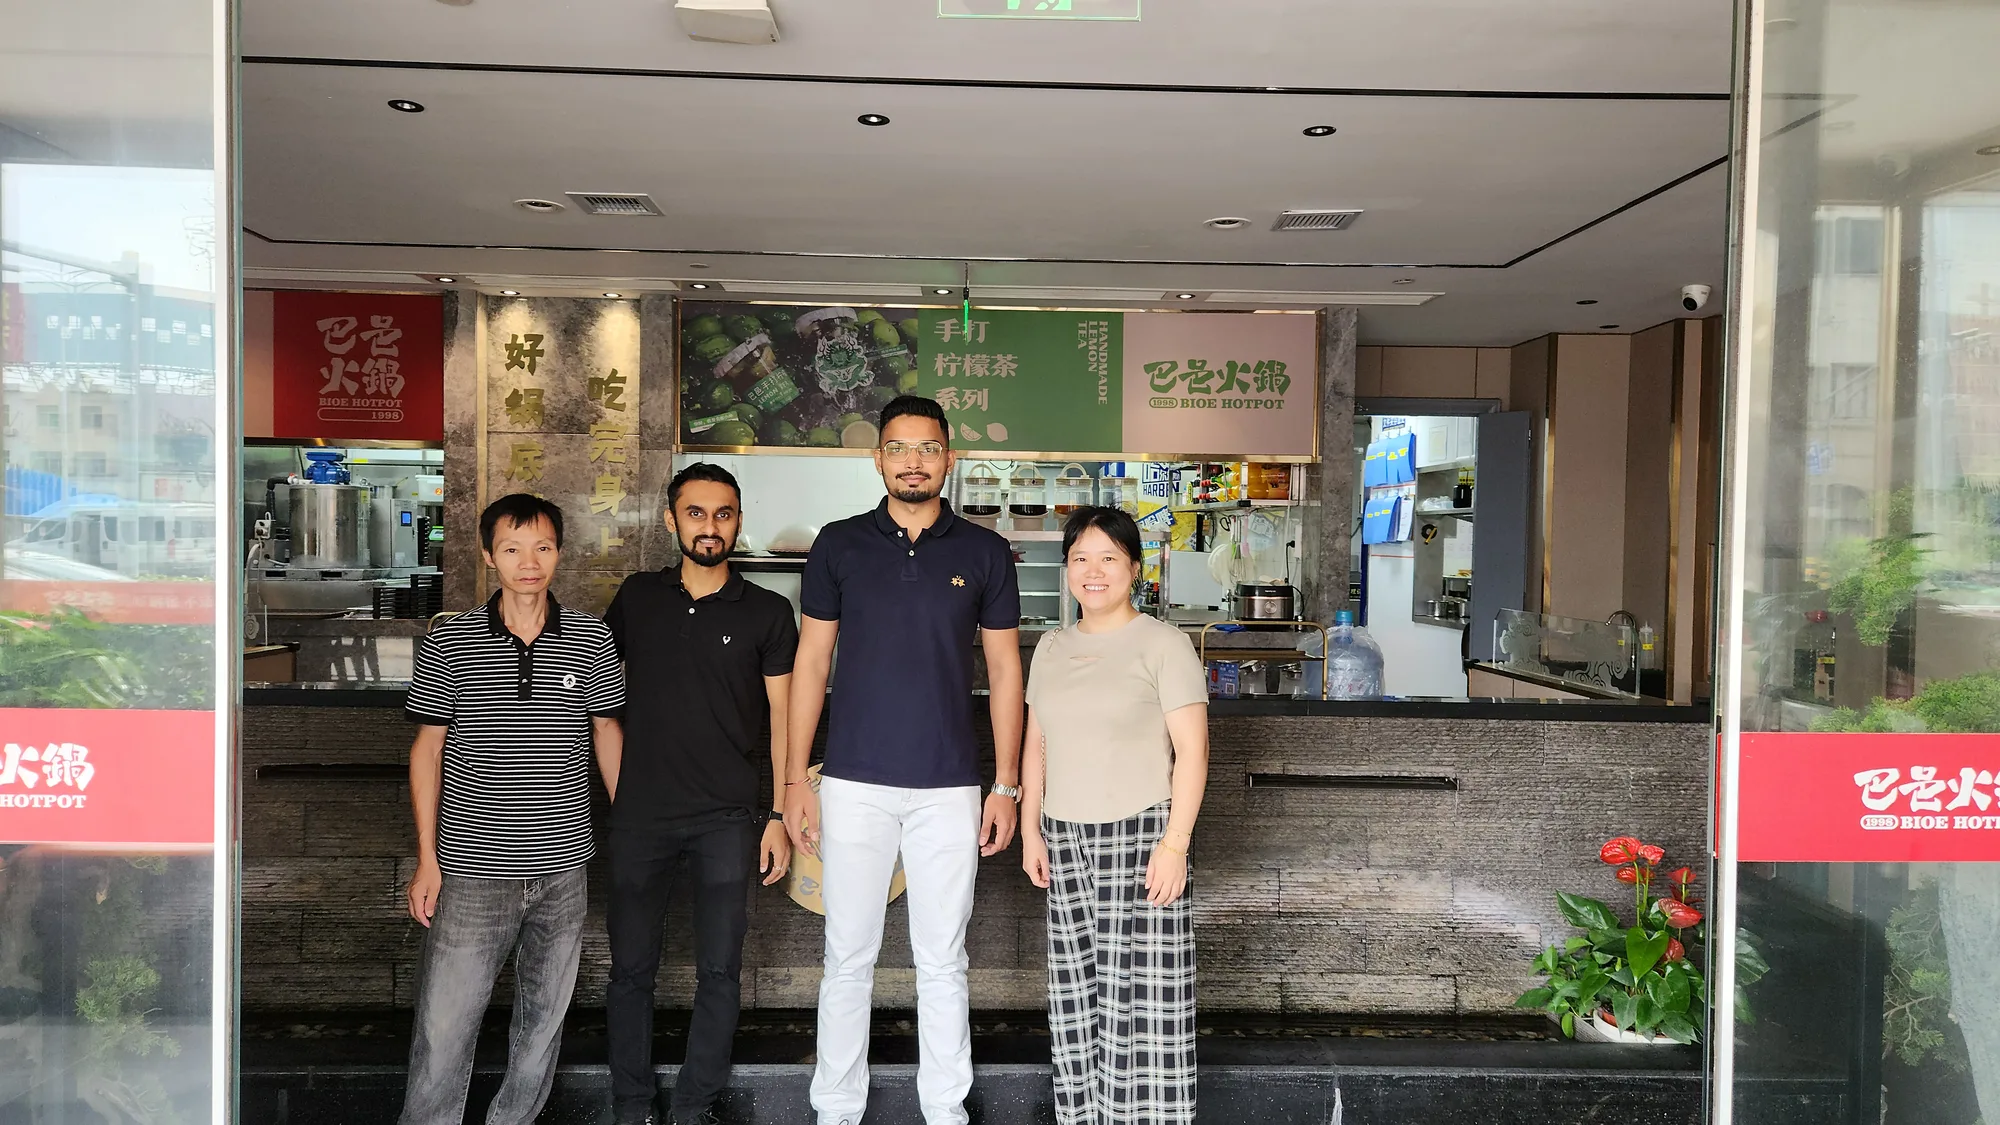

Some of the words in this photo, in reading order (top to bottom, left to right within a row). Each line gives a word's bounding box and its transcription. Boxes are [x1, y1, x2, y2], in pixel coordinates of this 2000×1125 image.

[934, 318, 991, 344] 手打
[1078, 320, 1088, 349] TEA
[1088, 321, 1098, 372] LEMON
[934, 352, 1019, 378] 柠檬茶
[1098, 321, 1108, 405] HANDMADE
[319, 398, 348, 406] BIOE
[352, 399, 402, 407] HOTPOT
[936, 386, 989, 412] 系列
[1180, 399, 1217, 408] BIOE
[1221, 399, 1285, 409] HOTPOT
[371, 411, 400, 420] 1998
[504, 333, 545, 500] 好锅底
[0, 793, 87, 808] HOTPOT
[1853, 765, 2000, 812] 巴邑火
[1865, 817, 1894, 827] 1998
[1900, 816, 1948, 829] BIOE
